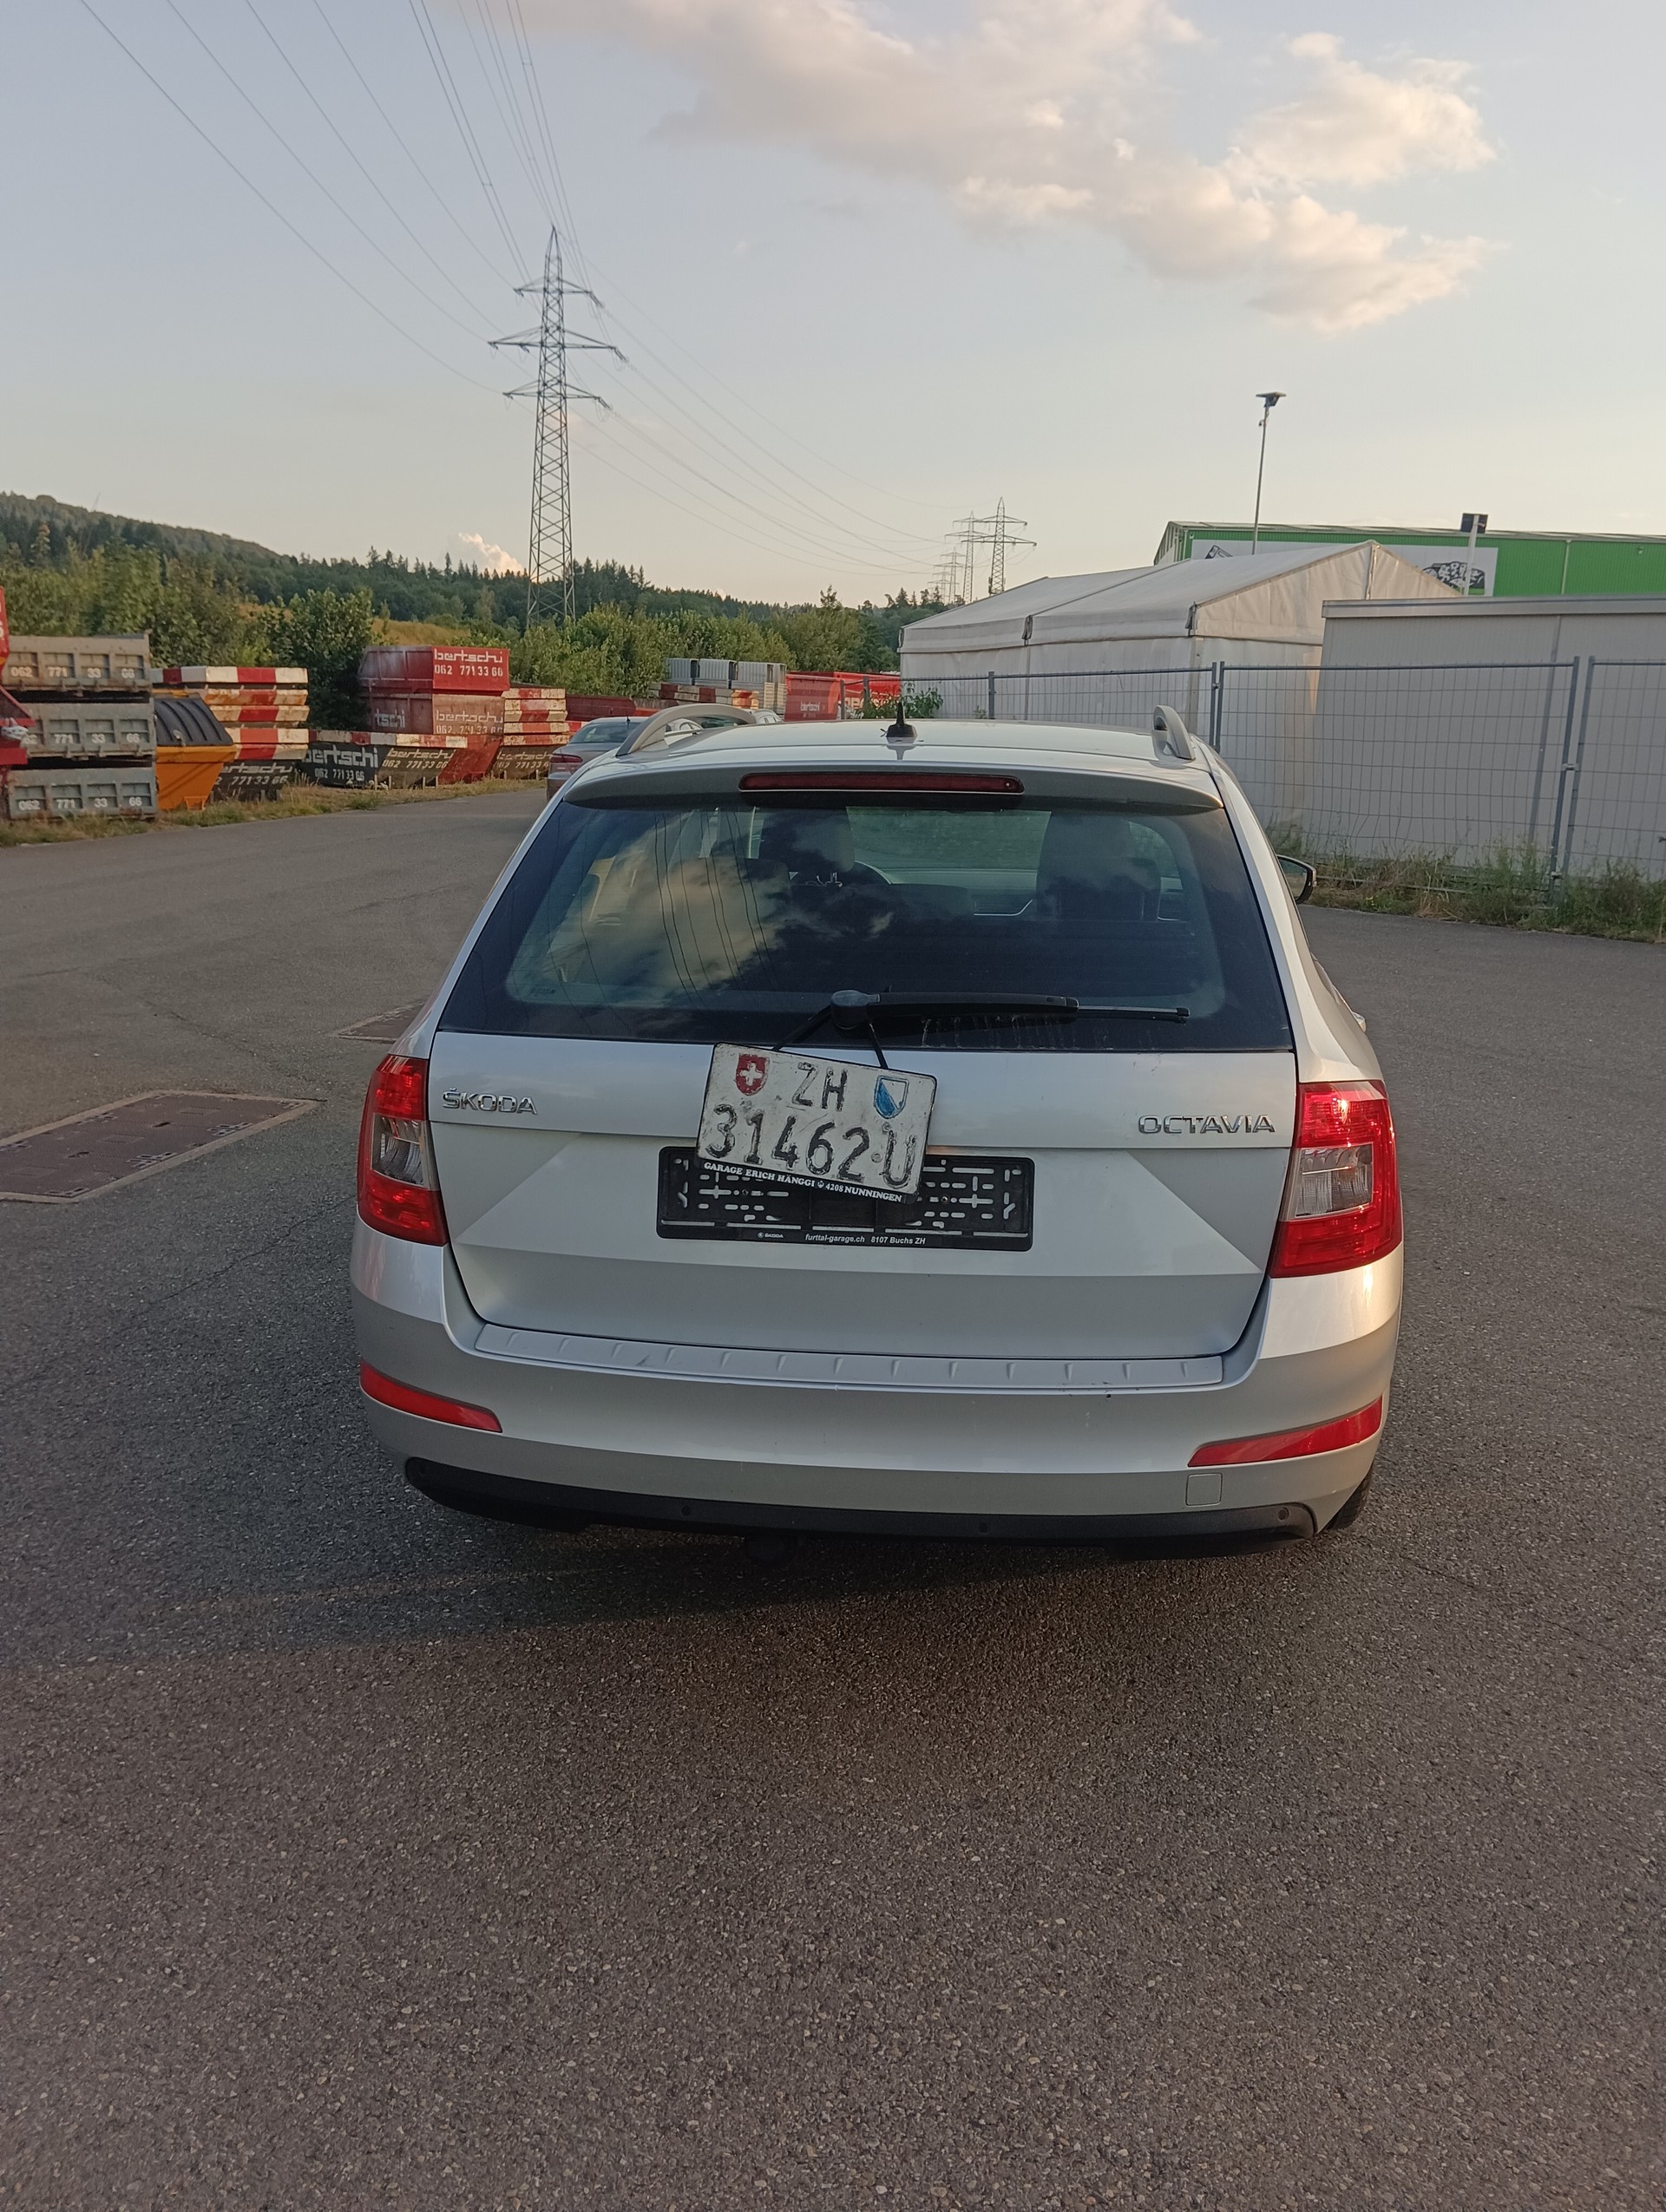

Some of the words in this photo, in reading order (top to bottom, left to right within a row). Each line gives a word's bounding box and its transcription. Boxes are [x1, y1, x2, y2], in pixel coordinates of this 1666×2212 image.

[434, 648, 503, 664] bertschi
[10, 666, 33, 677] 062
[48, 666, 68, 677] 771
[87, 667, 102, 678] 33
[434, 664, 452, 675] 062
[459, 665, 476, 676] 771
[477, 666, 489, 677] 33
[491, 666, 503, 677] 66
[436, 710, 503, 723] bertschi
[54, 734, 74, 744] 771
[91, 733, 105, 743] 33
[126, 733, 140, 743] 66
[387, 747, 456, 759] bertschi
[220, 762, 293, 774] ertschi
[382, 759, 401, 768] 062
[406, 760, 421, 769] 771
[231, 776, 253, 785] 771
[253, 776, 270, 785] 33
[315, 768, 328, 779] 062
[332, 769, 344, 780] 771
[355, 770, 365, 782] 66
[18, 800, 41, 810] 062
[56, 799, 75, 808] 771
[94, 798, 108, 808] 33
[128, 796, 142, 807] 66
[791, 1061, 848, 1112] ZH
[442, 1087, 538, 1116] ŠKODA
[1138, 1114, 1276, 1135] OCTAVIA
[704, 1161, 744, 1175] GARAGE
[744, 1168, 776, 1181] ERICH
[777, 1173, 816, 1188] HÄNGGI
[825, 1182, 844, 1193] 4208
[843, 1185, 902, 1203] NUNNINGEN
[804, 1233, 865, 1244] furttal-garage.ch
[870, 1235, 889, 1244] 8107
[889, 1236, 914, 1245] Buchs
